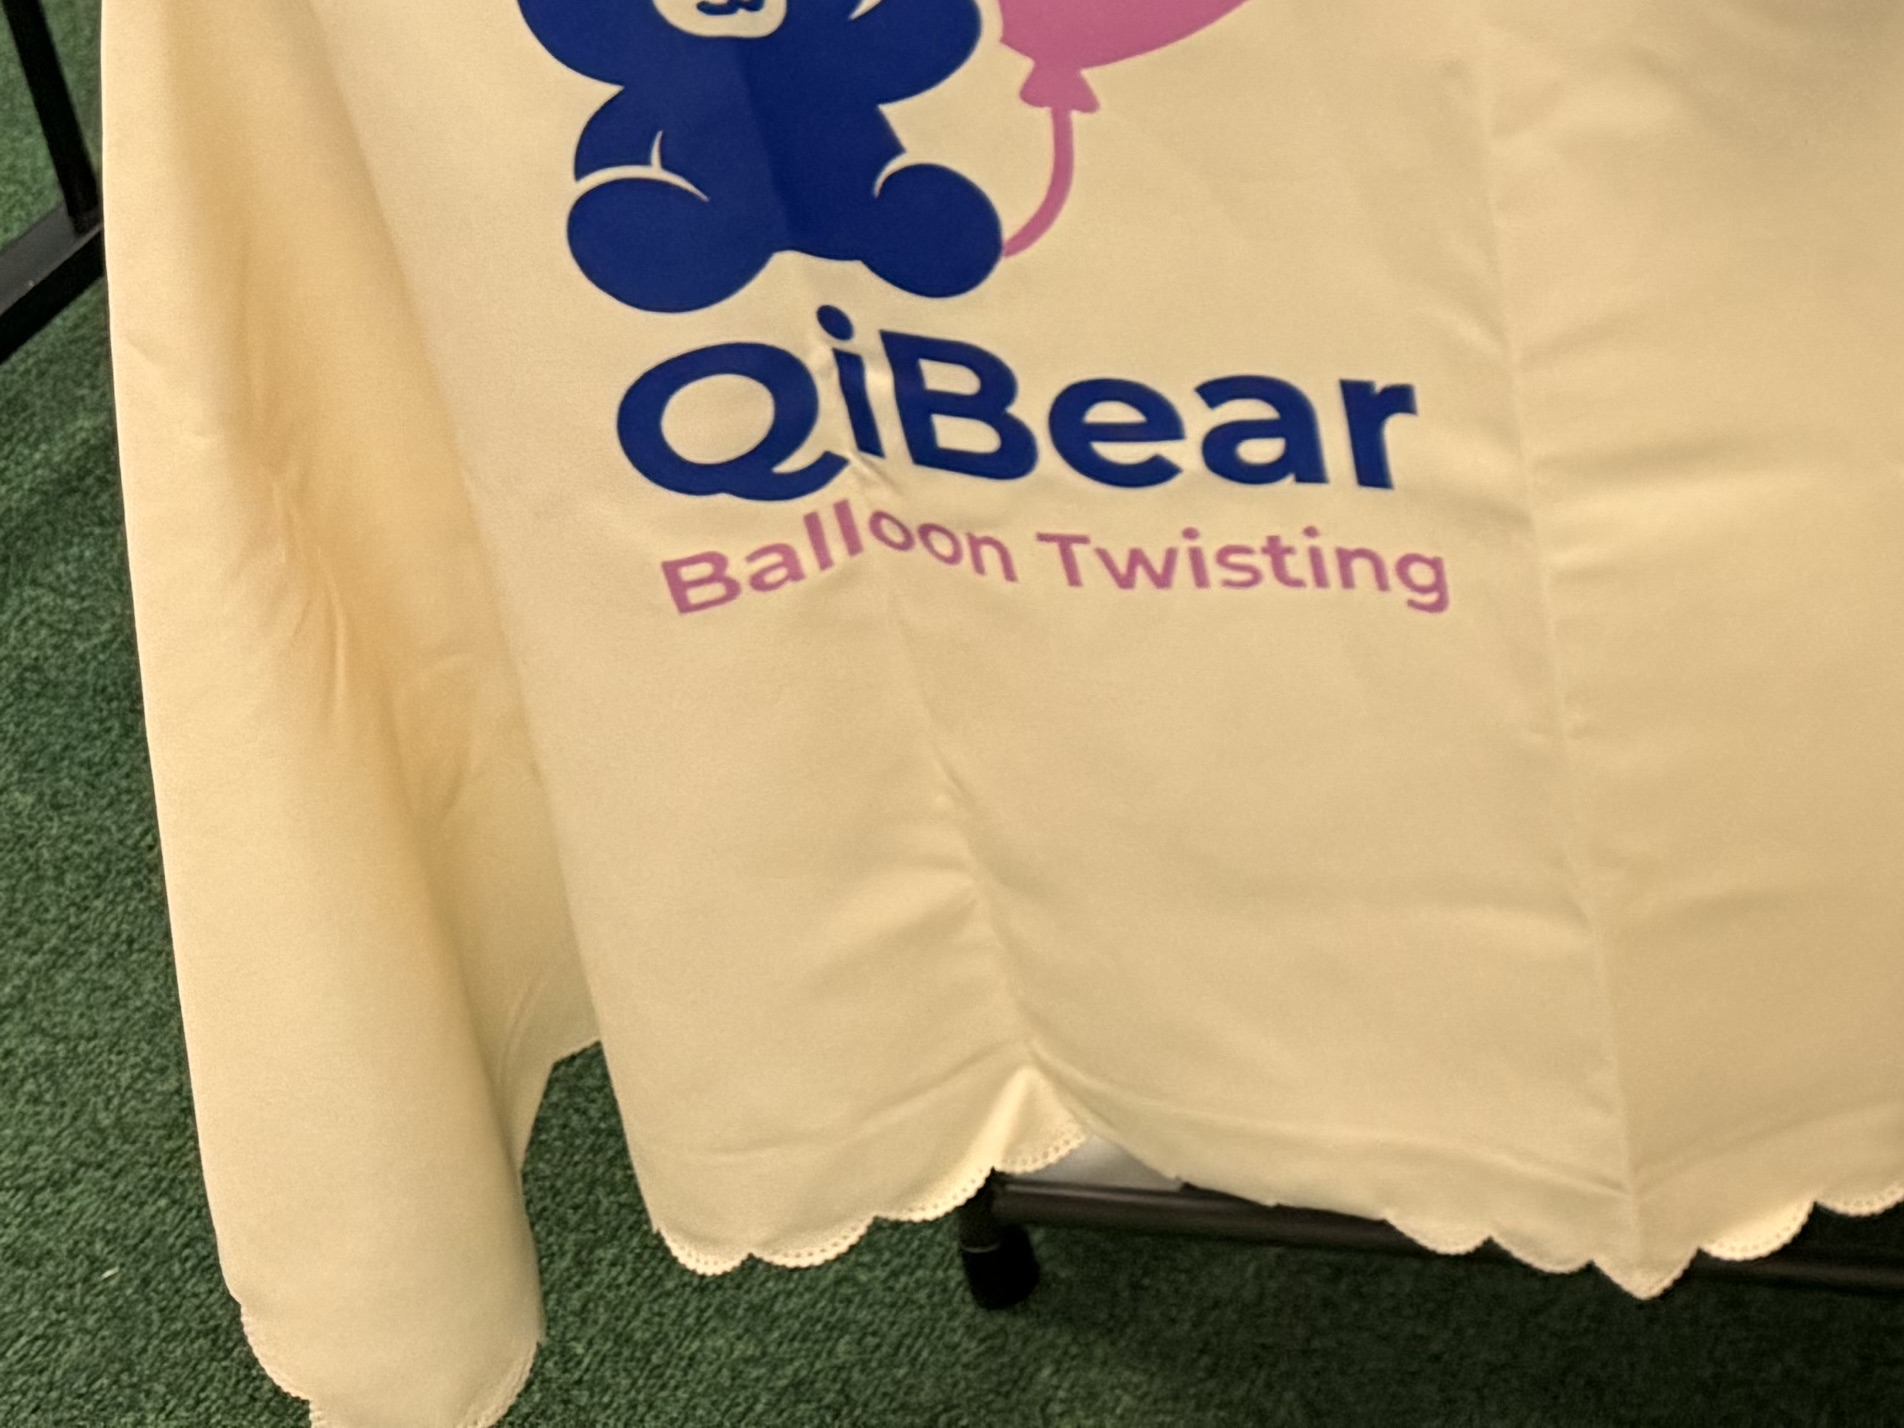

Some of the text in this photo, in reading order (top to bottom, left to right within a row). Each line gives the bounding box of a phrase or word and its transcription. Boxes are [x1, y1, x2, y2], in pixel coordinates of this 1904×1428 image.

[616, 303, 1418, 503] QiBear
[659, 498, 1450, 616] Balloon Twisting
